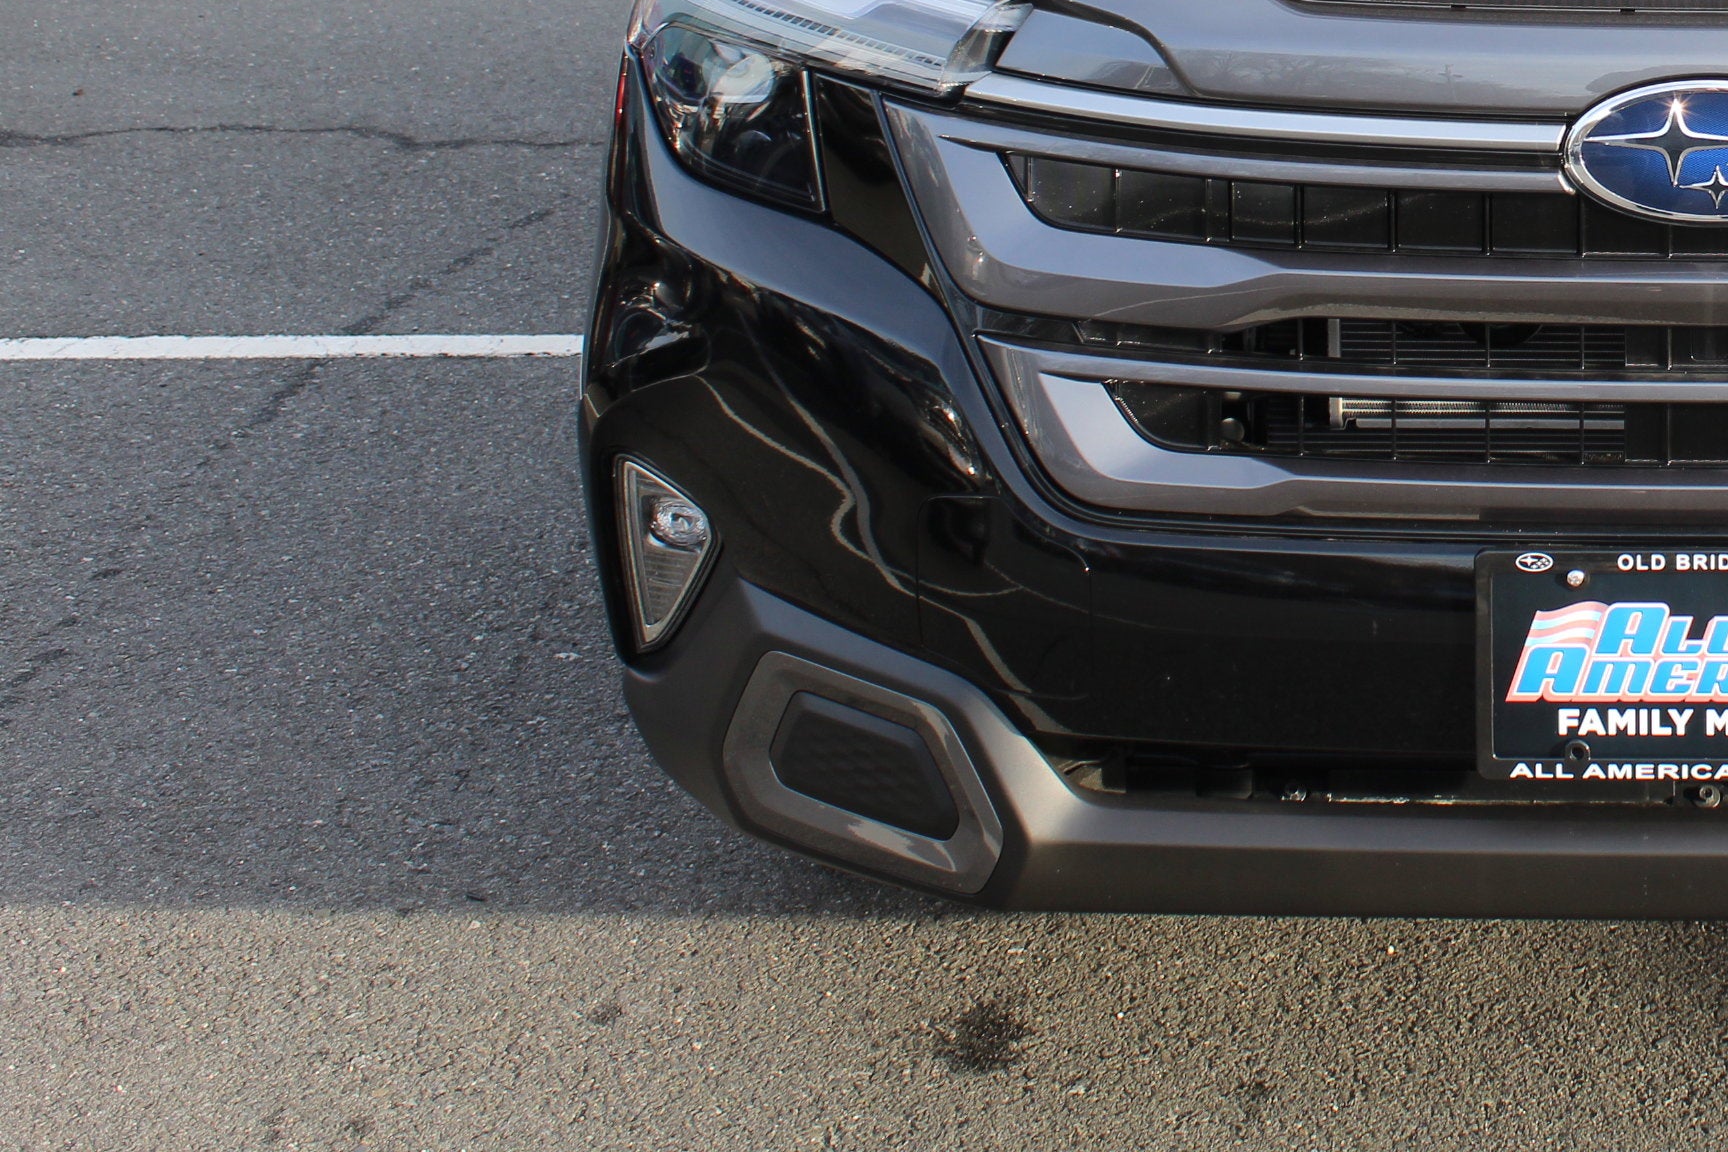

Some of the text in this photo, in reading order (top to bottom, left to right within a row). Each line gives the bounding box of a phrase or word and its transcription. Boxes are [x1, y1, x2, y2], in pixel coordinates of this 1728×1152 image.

[1617, 554, 1666, 571] OLD
[1558, 708, 1694, 736] FAMILY
[1509, 763, 1574, 779] ALL
